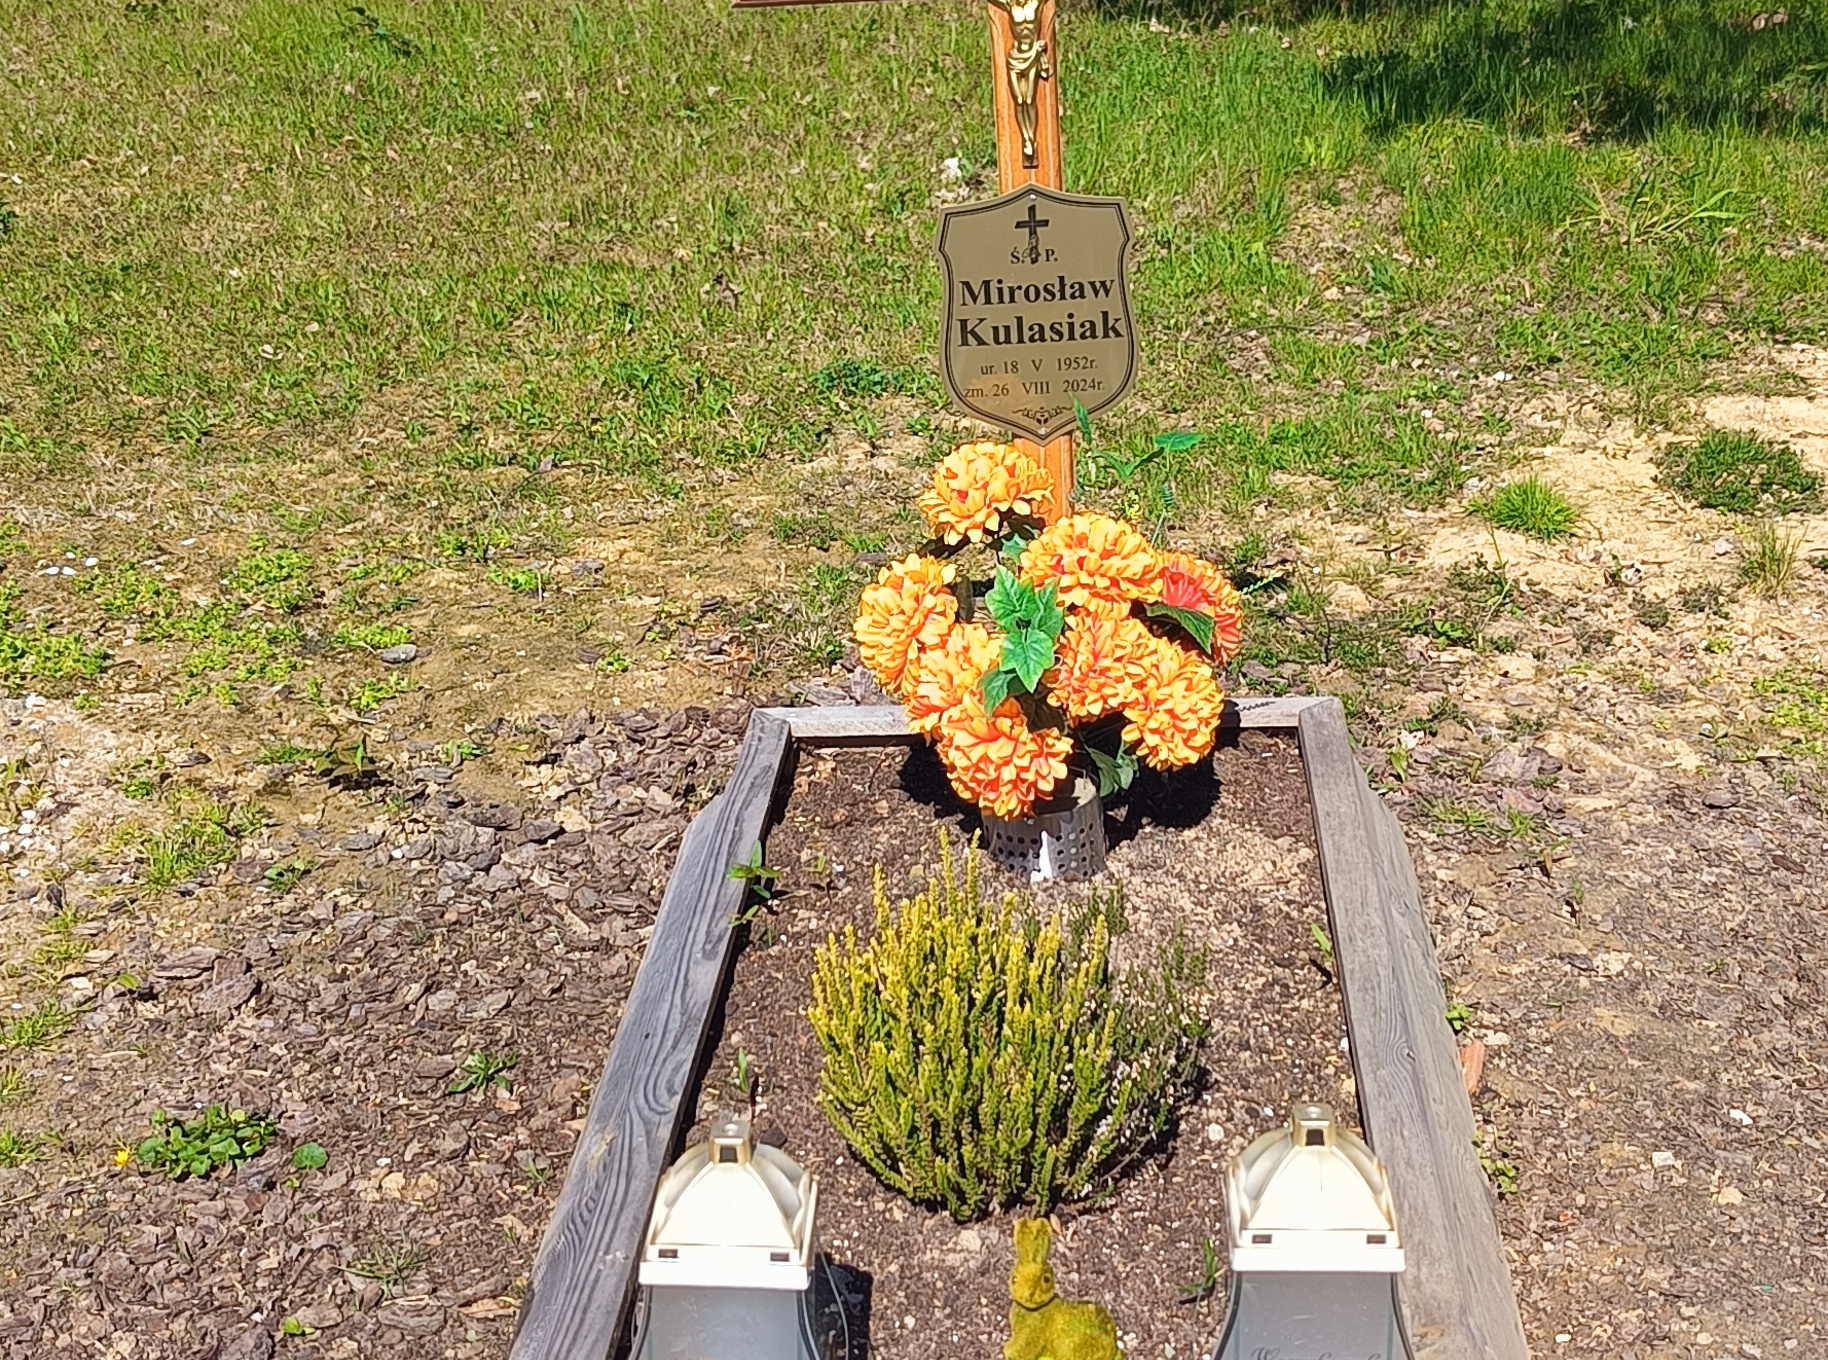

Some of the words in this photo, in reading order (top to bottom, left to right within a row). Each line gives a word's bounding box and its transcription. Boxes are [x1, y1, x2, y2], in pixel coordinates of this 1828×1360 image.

[1010, 247, 1026, 265] Ś.
[1045, 248, 1059, 262] P.
[959, 275, 1115, 306] Mirosław
[956, 310, 1125, 348] Kulasiak
[980, 363, 998, 376] ur.
[1003, 360, 1019, 374] 18
[1031, 358, 1044, 372] V
[1056, 356, 1098, 371] 1952r.
[964, 385, 989, 398] zm.
[992, 384, 1010, 397] 26
[1021, 381, 1051, 395] VIII
[1062, 378, 1106, 393] 2024r.
